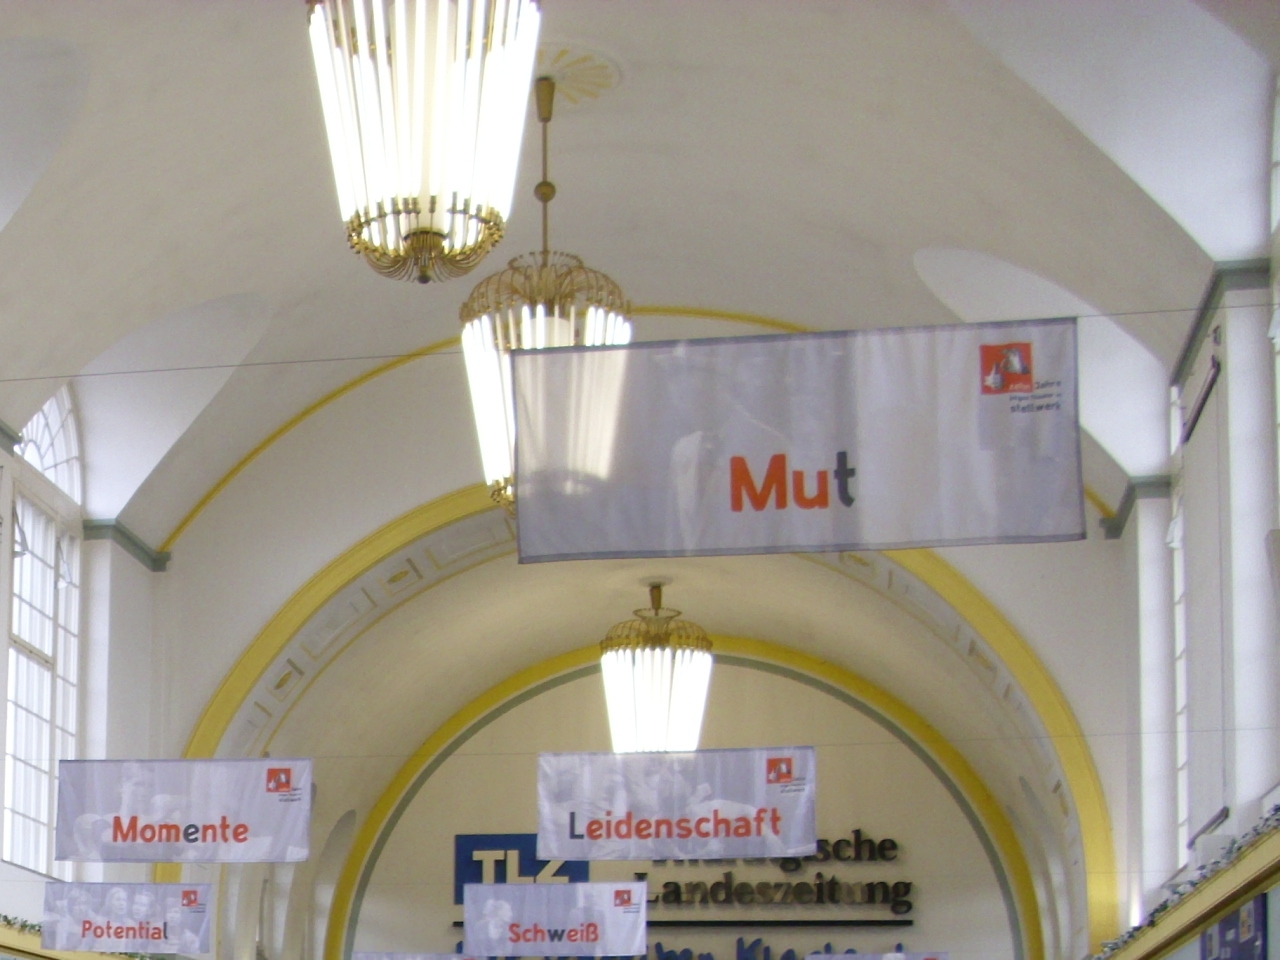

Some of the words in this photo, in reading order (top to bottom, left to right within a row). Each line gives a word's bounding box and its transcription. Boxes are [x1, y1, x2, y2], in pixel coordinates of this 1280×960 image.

[729, 451, 856, 512] Mut
[112, 815, 249, 844] Momente
[569, 807, 782, 842] Leidenschaft
[472, 850, 570, 884] TLZ
[81, 920, 168, 941] Potential
[508, 923, 599, 943] Schweiß
